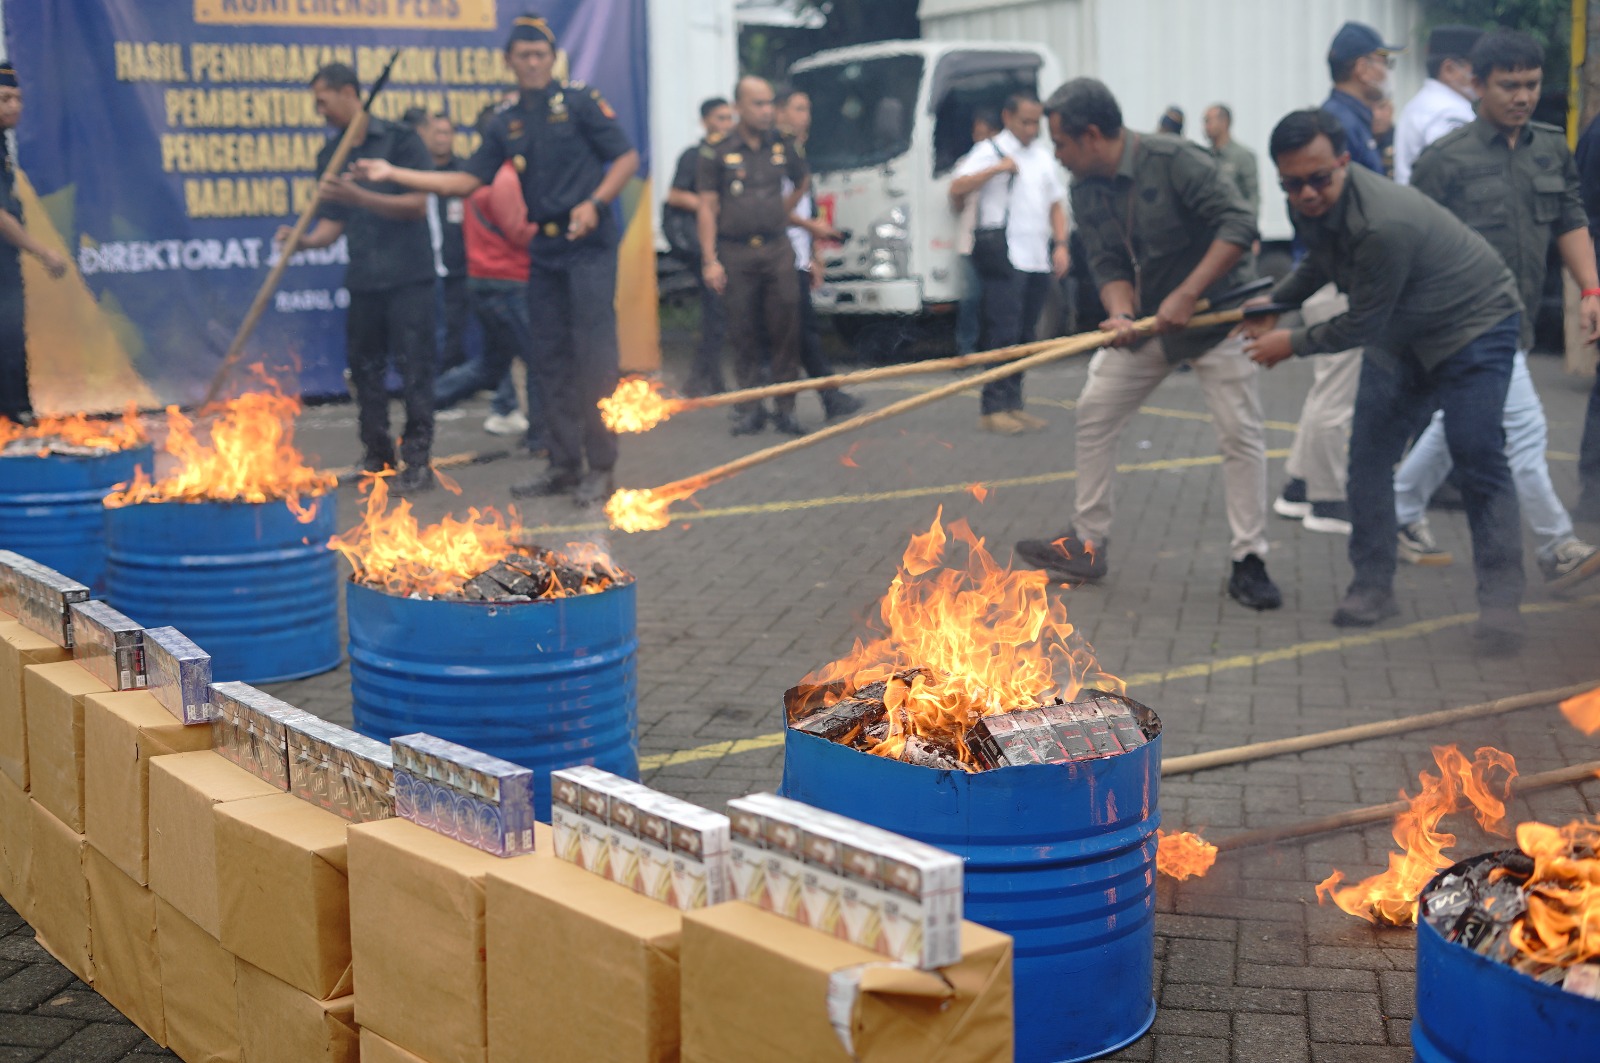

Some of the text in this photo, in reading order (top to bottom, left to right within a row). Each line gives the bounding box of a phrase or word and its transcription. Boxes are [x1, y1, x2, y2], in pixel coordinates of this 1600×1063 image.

[114, 41, 189, 81] HASIL
[440, 46, 518, 85] ILEGA
[164, 88, 327, 128] PEMBENTUK
[184, 177, 289, 218] BARANG
[79, 237, 263, 275] DIREKTORAT
